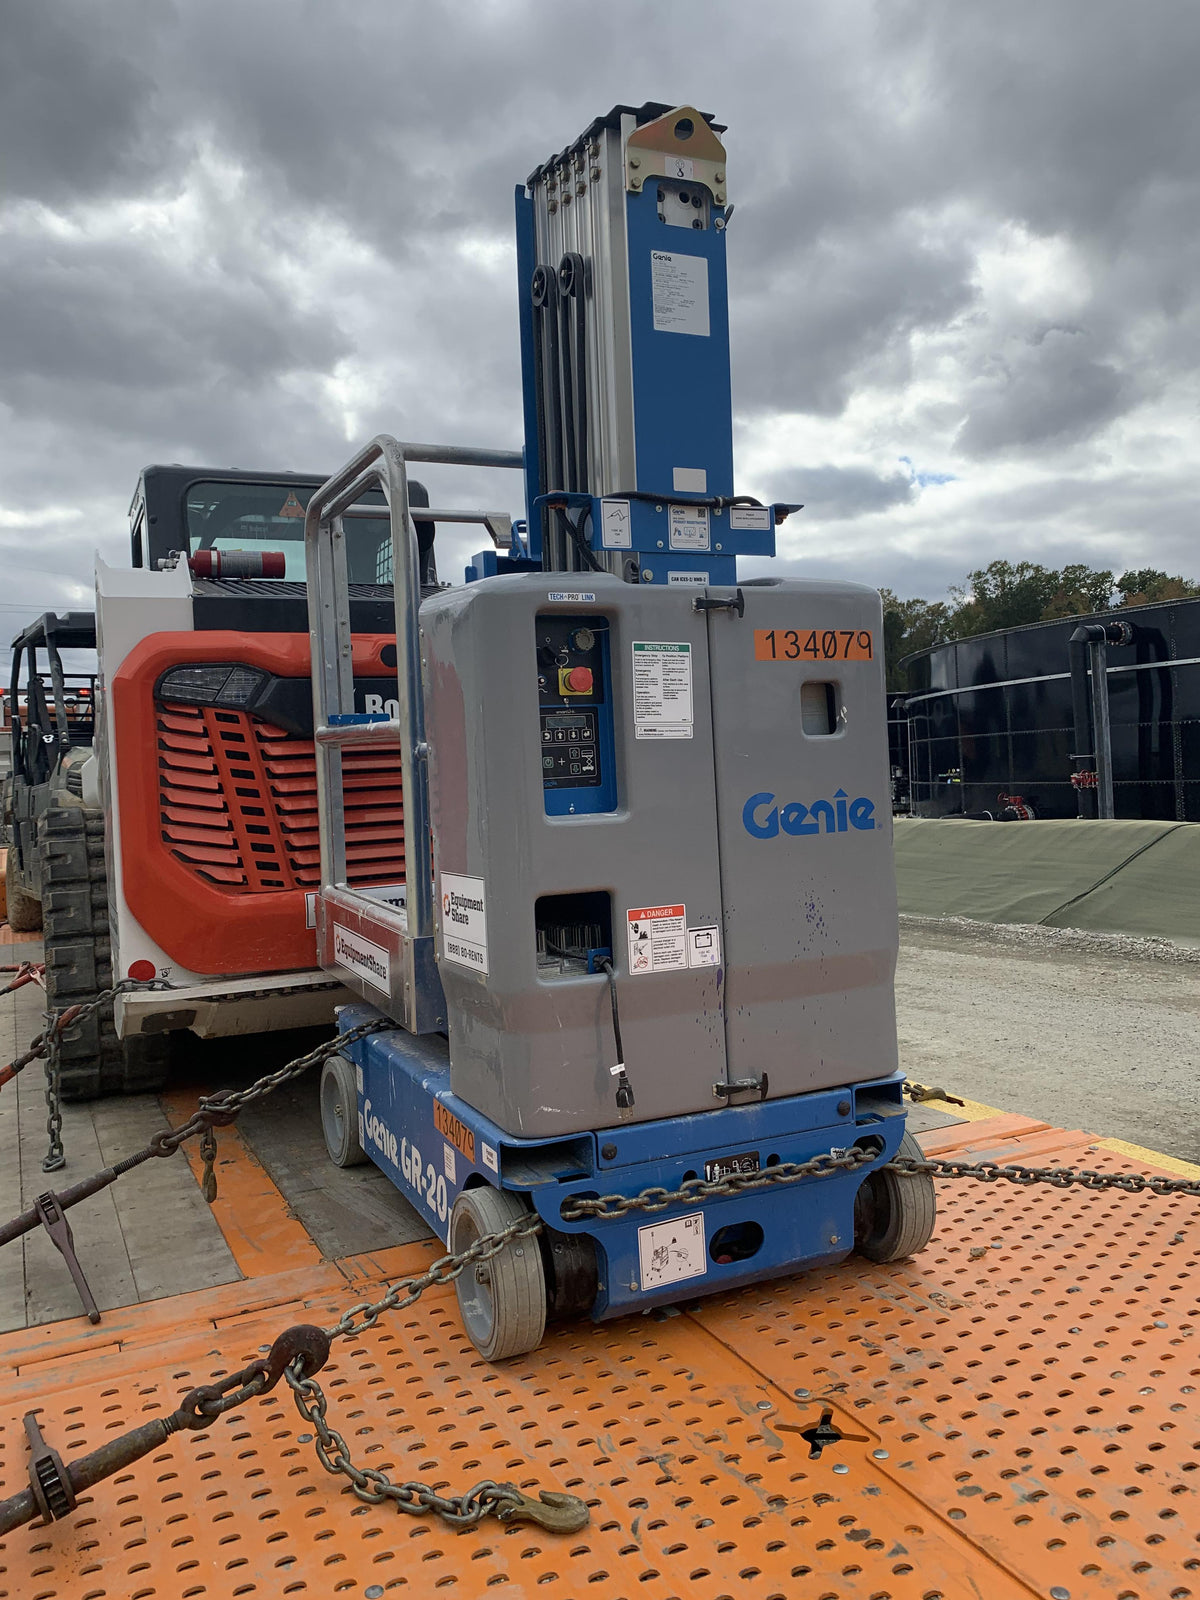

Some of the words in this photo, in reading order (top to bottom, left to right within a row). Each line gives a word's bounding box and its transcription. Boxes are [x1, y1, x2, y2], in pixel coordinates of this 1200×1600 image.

[653, 253, 672, 262] Genie
[765, 630, 872, 659] 134079
[742, 788, 876, 840] Genie
[451, 892, 484, 913] Equipment
[451, 908, 469, 925] Share
[647, 908, 673, 917] DANGER
[341, 937, 387, 980] EquipmentShare
[436, 1103, 475, 1163] 134079
[364, 1098, 400, 1170] Genie
[401, 1136, 448, 1223] GR-20
